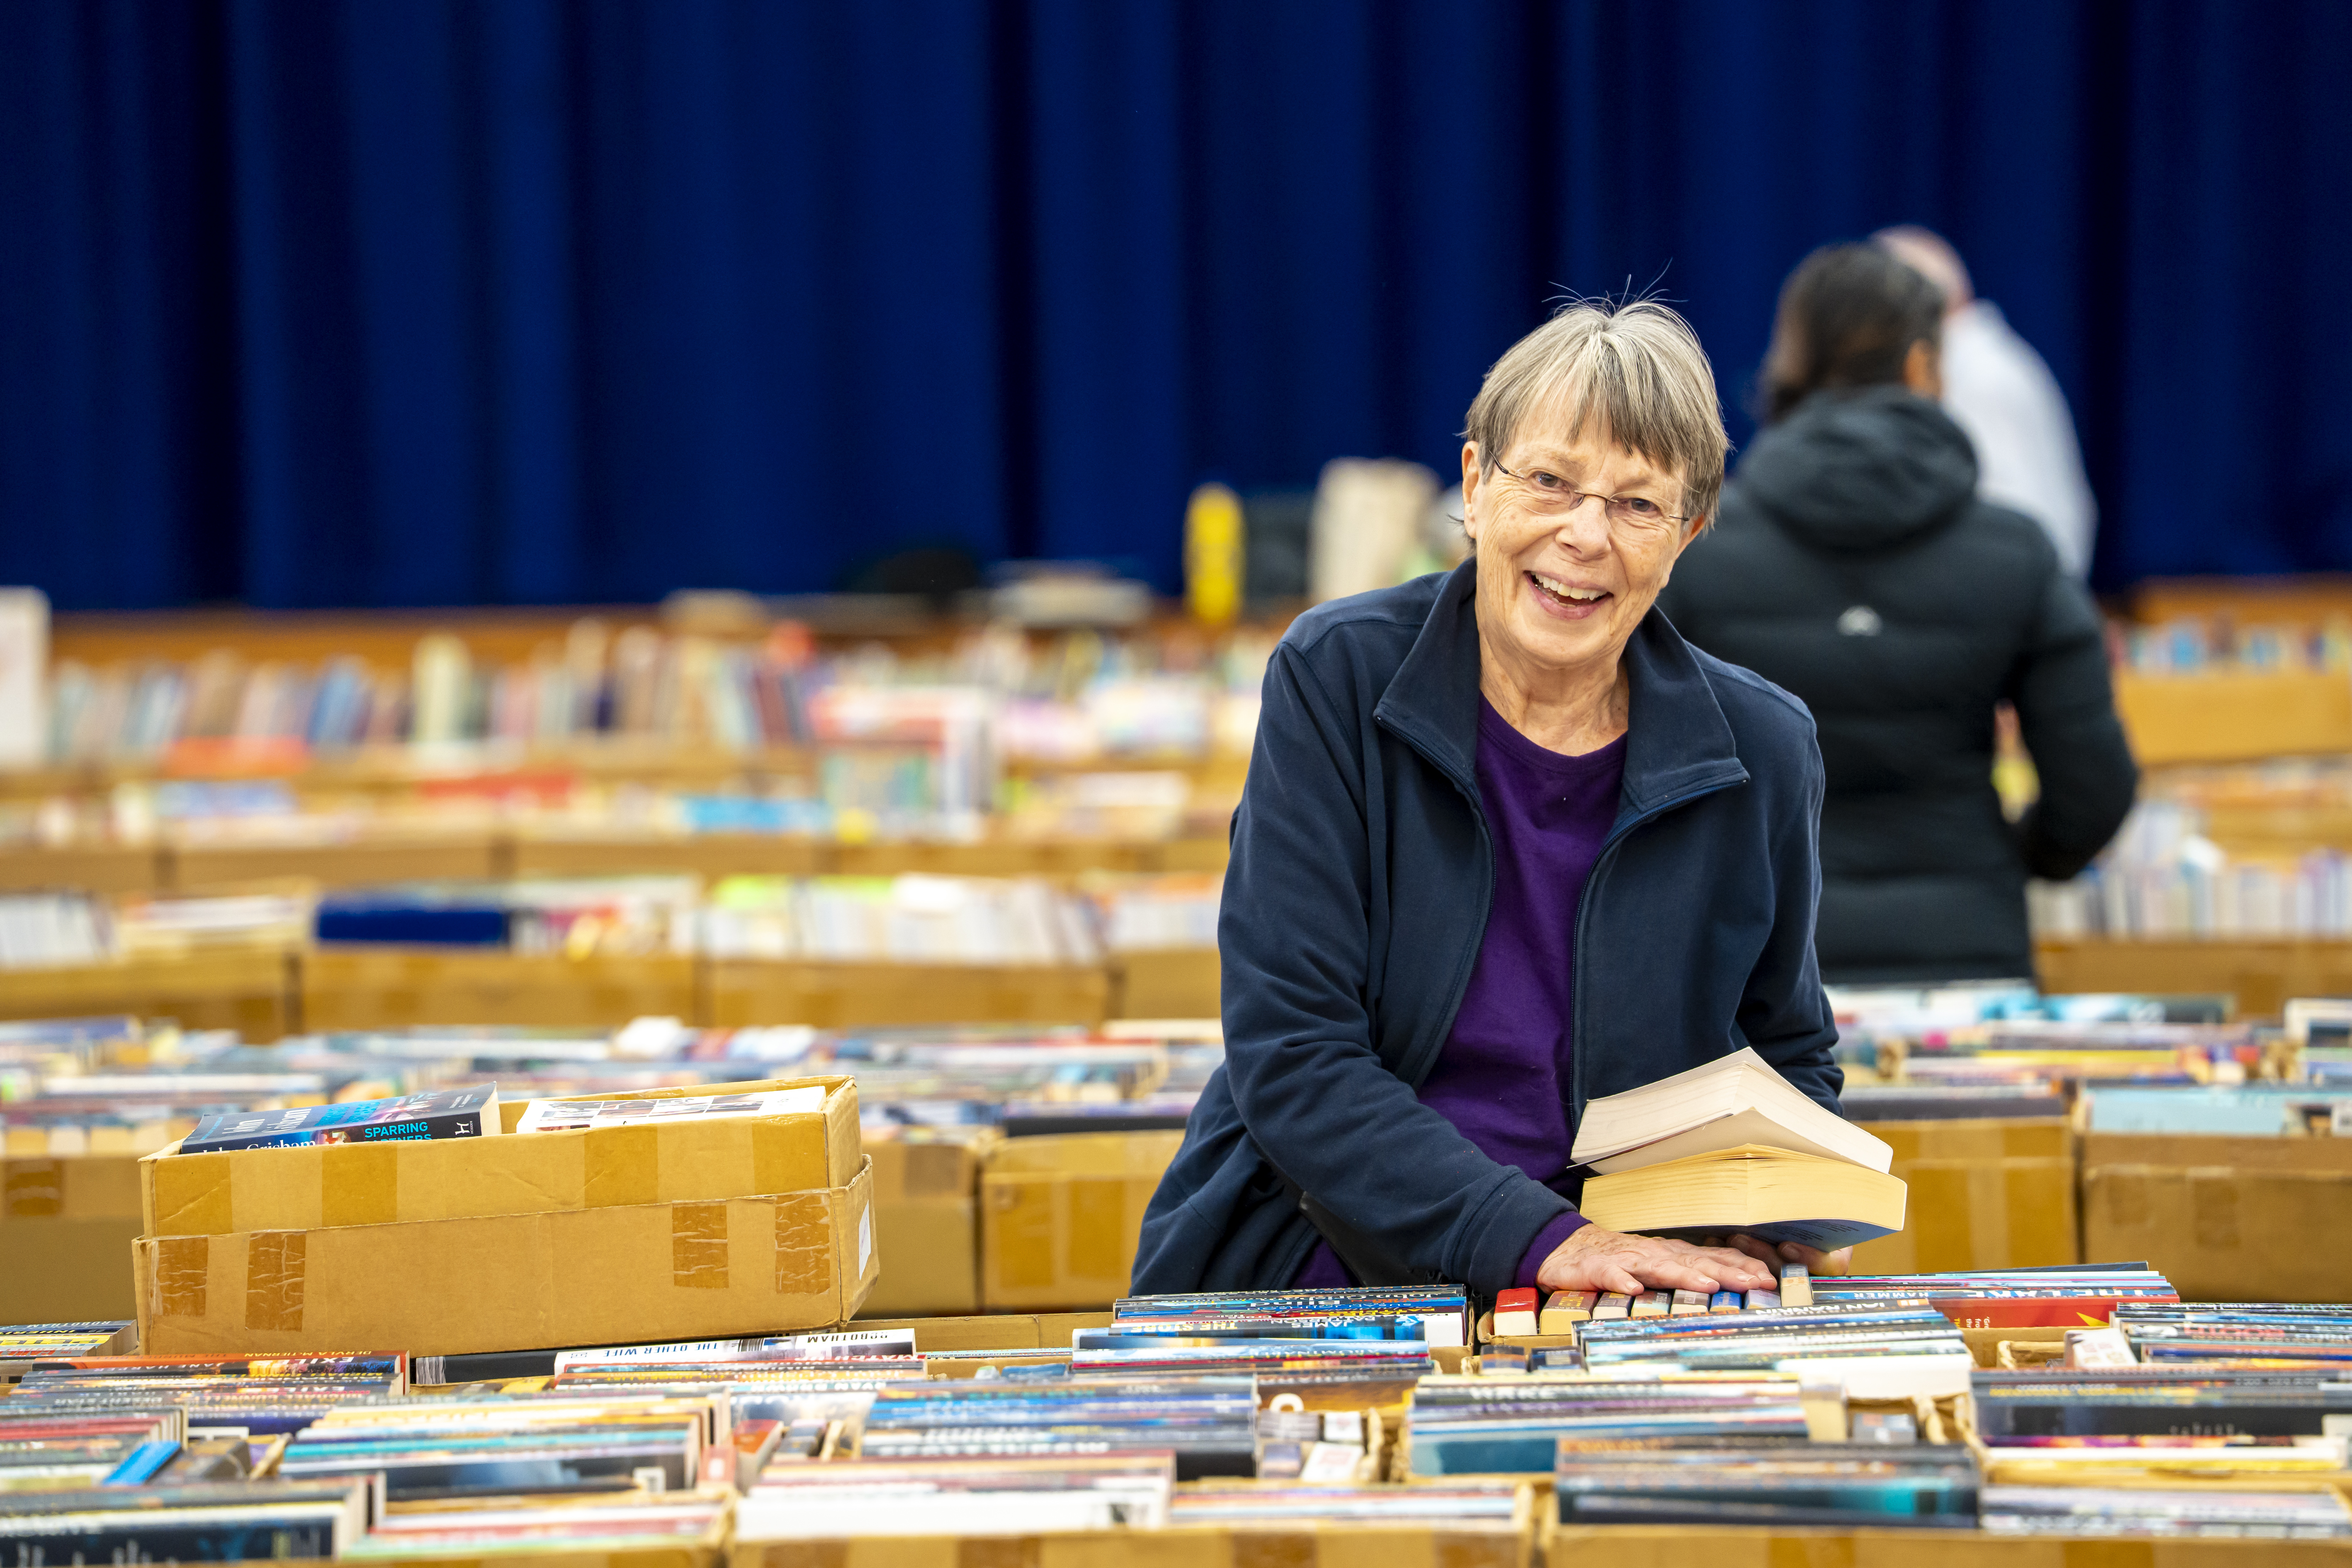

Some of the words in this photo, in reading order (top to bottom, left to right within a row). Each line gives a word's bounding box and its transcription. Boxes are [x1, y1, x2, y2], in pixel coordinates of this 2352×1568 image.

[365, 1122, 428, 1138] SPARRING
[246, 1140, 316, 1151] Giham
[1755, 1305, 1840, 1315] RANKIN
[1846, 1302, 1886, 1310] IAN
[1130, 1324, 1194, 1333] STORE
[807, 1332, 888, 1343] ROBOTHAM
[644, 1345, 689, 1354] OTHER
[695, 1343, 718, 1351] THE
[602, 1348, 638, 1357] WIFE
